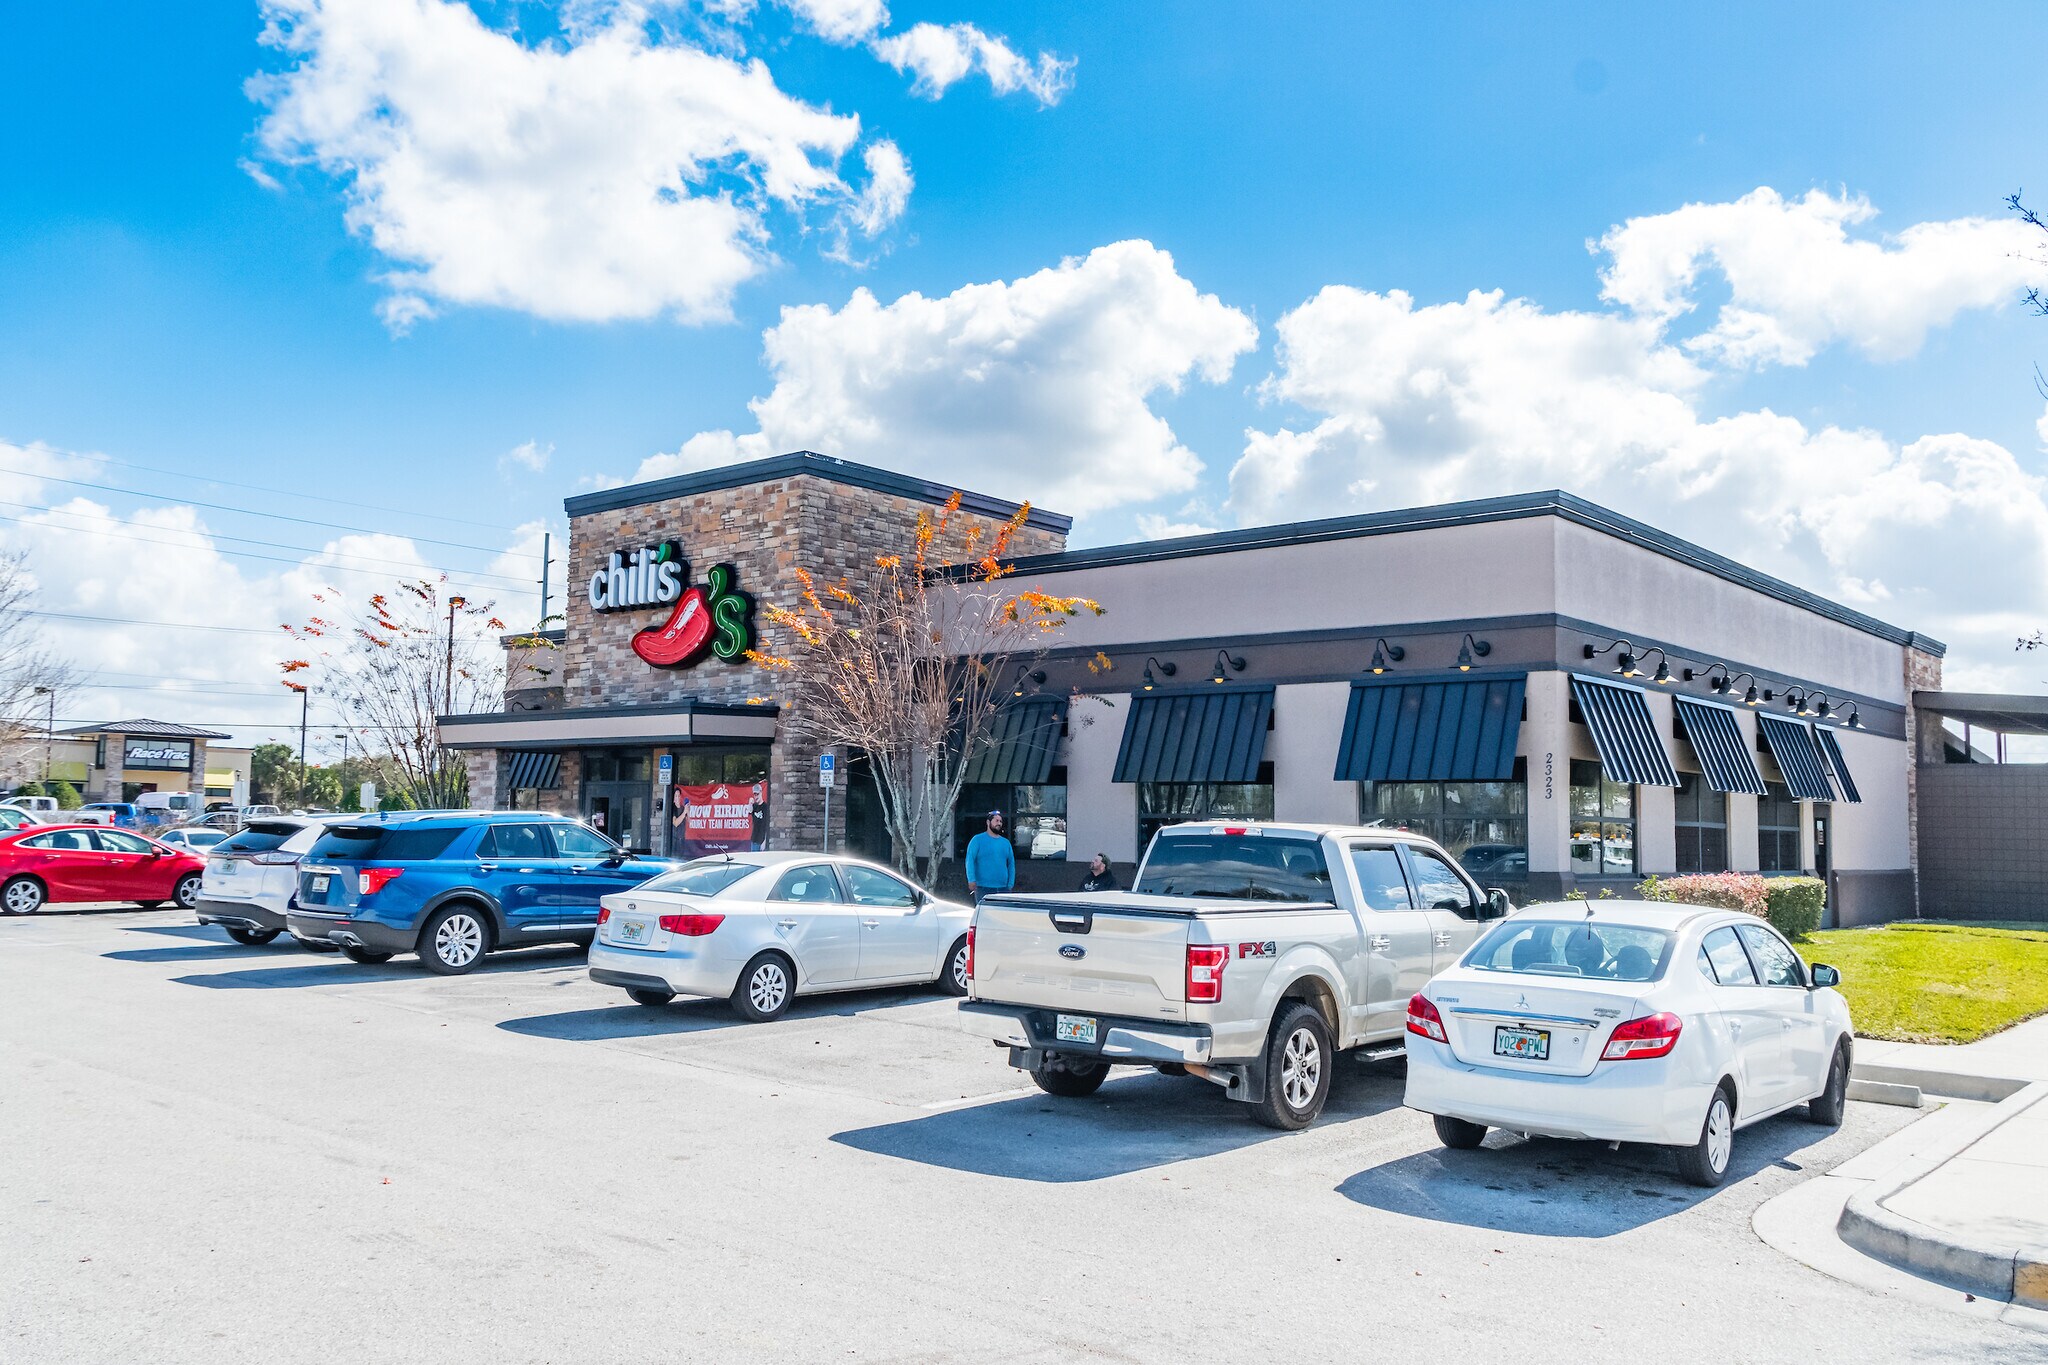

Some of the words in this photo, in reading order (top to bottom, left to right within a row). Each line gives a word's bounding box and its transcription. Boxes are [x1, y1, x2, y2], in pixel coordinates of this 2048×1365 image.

[589, 544, 682, 610] chili's
[129, 747, 190, 760] RaceTrac
[1545, 752, 1553, 800] 2323
[689, 804, 712, 818] NOW
[714, 804, 749, 818] HIRING
[689, 819, 707, 829] HOURLY
[708, 819, 723, 829] TEAM
[723, 819, 750, 829] MEMBERS
[1062, 946, 1080, 957] Ford
[1239, 941, 1277, 959] FX4
